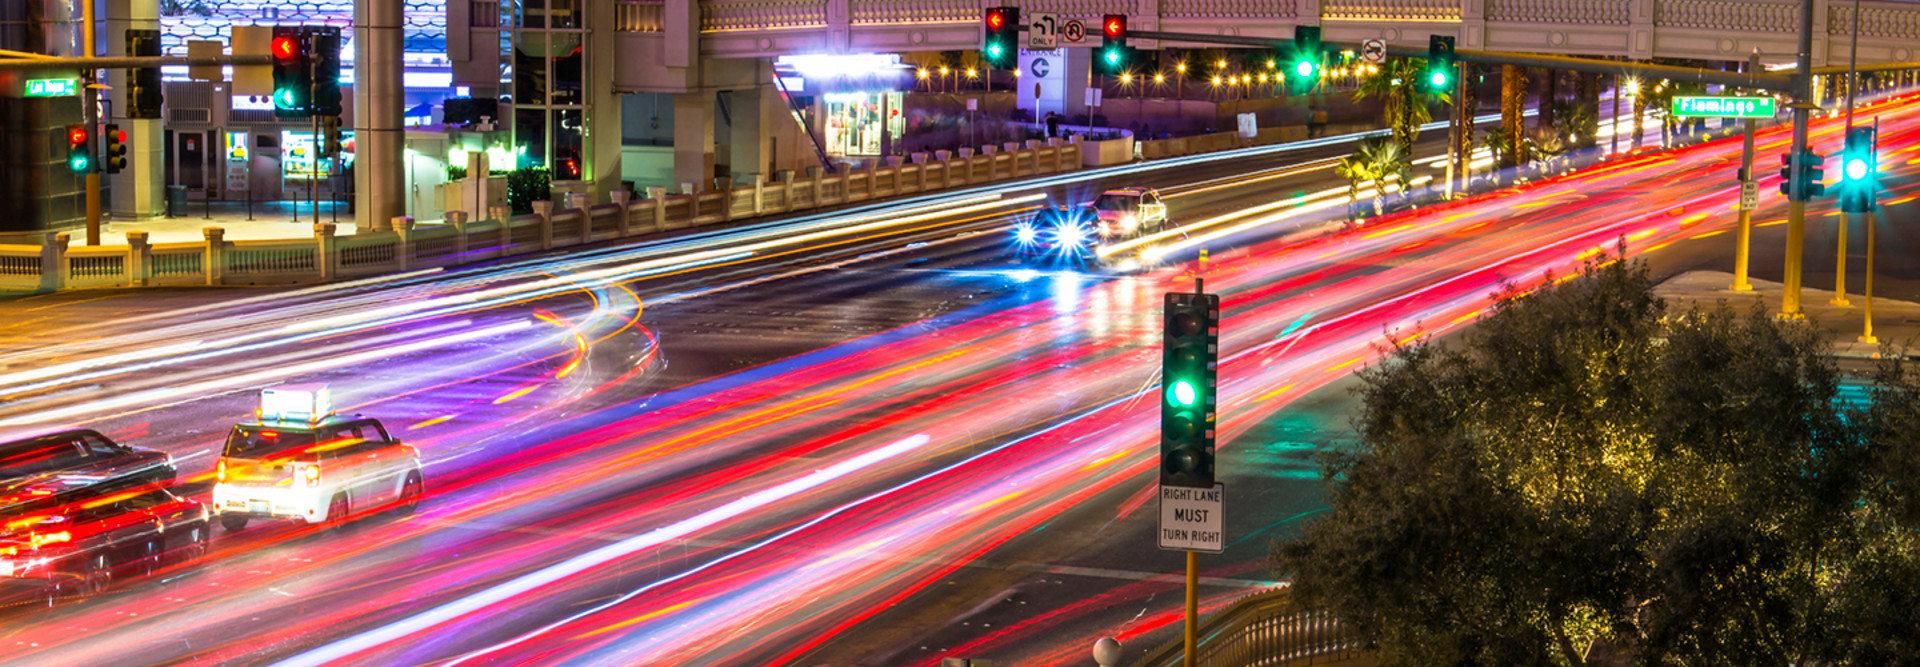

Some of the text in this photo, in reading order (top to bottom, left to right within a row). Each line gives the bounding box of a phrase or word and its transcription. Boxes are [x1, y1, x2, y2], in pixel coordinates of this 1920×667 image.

[1032, 38, 1053, 46] ONLY
[1680, 98, 1755, 117] Flamingo
[1163, 488, 1221, 502] RIGHT LANE
[1174, 508, 1209, 523] MUST
[1163, 528, 1220, 543] TURN RIGHT
